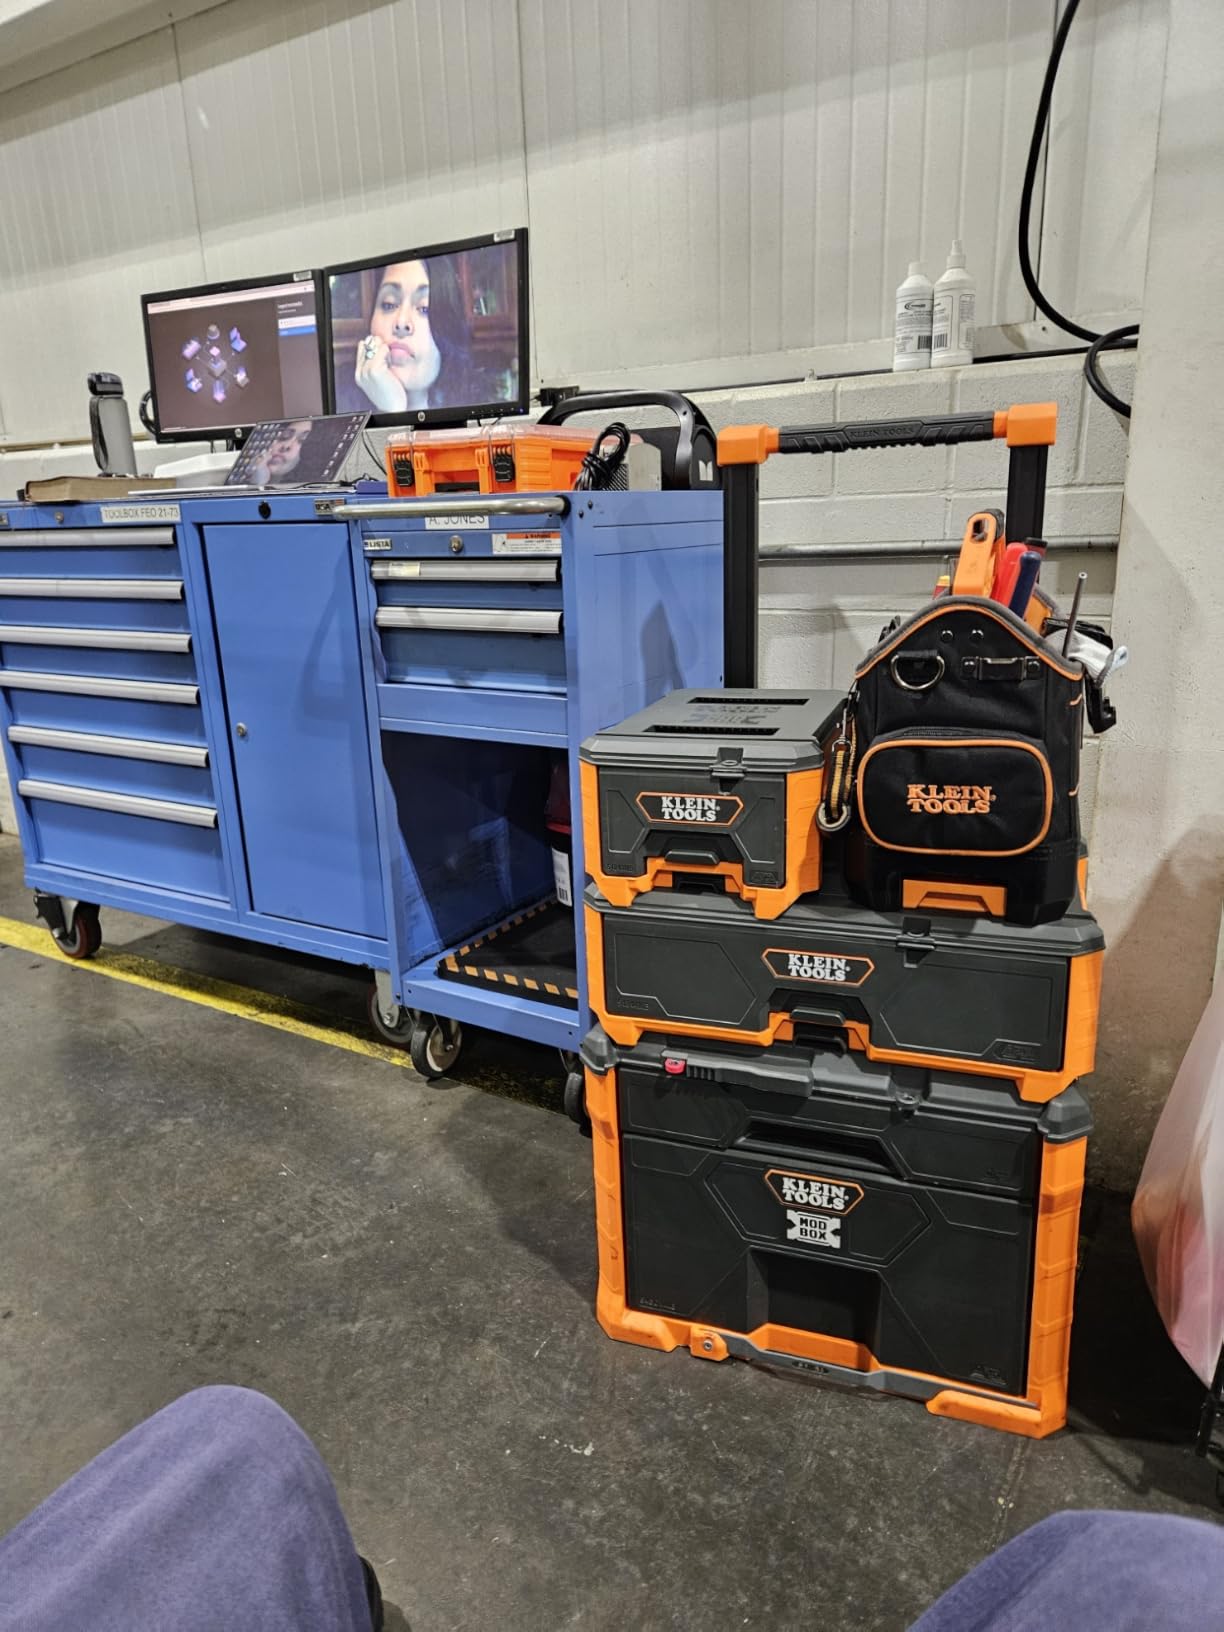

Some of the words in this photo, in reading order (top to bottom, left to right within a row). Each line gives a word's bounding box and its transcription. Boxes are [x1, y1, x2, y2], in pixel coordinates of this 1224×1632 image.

[104, 508, 140, 520] TOOLBOX
[444, 513, 485, 525] JONES
[369, 540, 390, 548] LISTA
[907, 783, 993, 801] KLEIN
[661, 796, 717, 811] KLEIN
[906, 798, 990, 815] TOOLS
[661, 808, 717, 822] TOOLS
[788, 953, 847, 970] KLEIN
[788, 965, 846, 982] TOOLS
[782, 1177, 846, 1199] KLEIN
[782, 1189, 845, 1211] TOOLS
[799, 1217, 827, 1230] MOD
[799, 1228, 827, 1241] BOX
